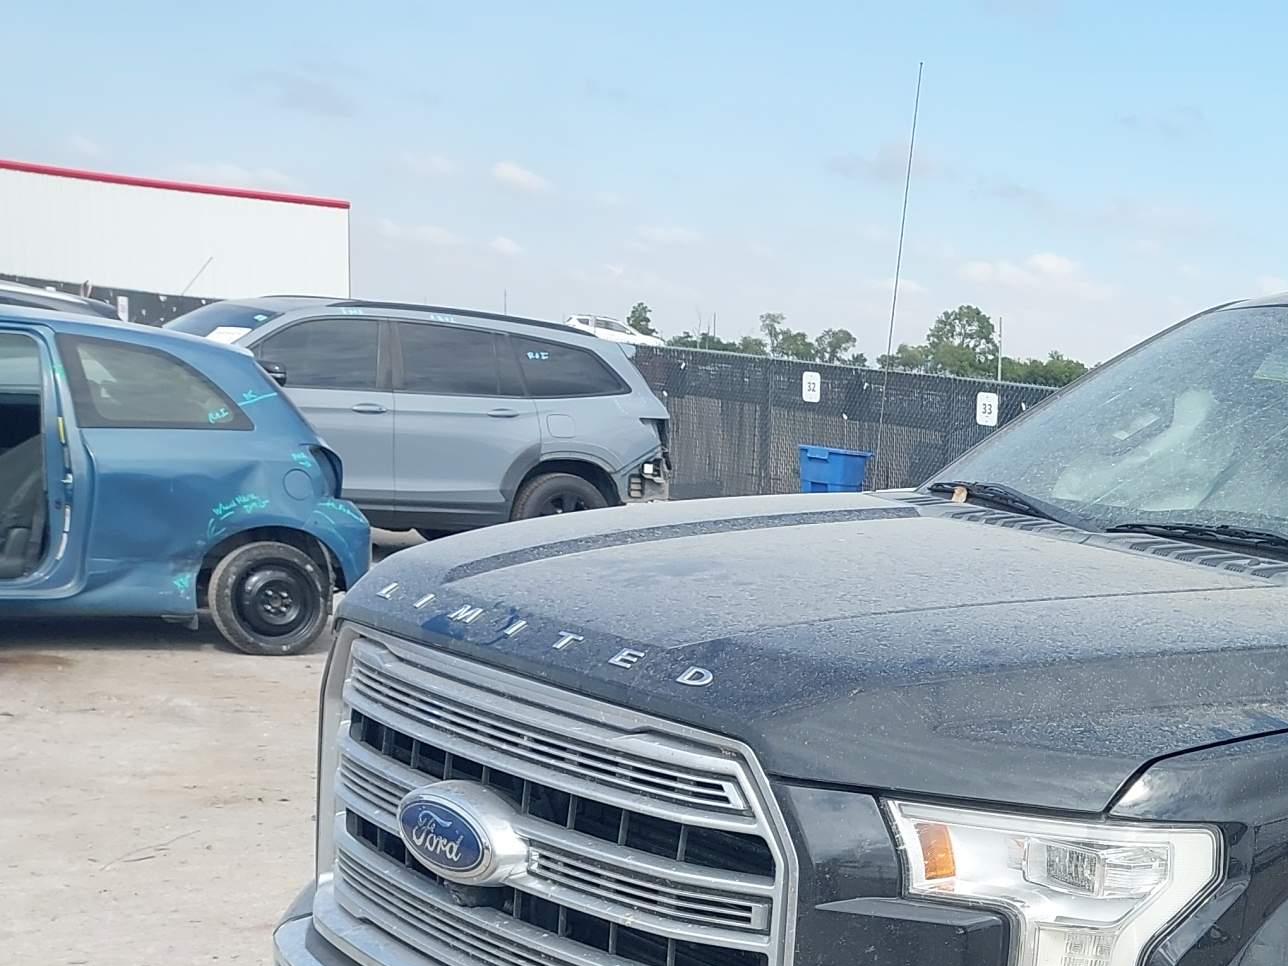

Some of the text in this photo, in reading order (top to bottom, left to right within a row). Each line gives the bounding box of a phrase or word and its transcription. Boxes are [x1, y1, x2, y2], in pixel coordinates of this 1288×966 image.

[807, 382, 817, 393] 32
[981, 402, 993, 415] 33
[376, 582, 715, 687] LIMITED
[412, 809, 464, 862] Ford
